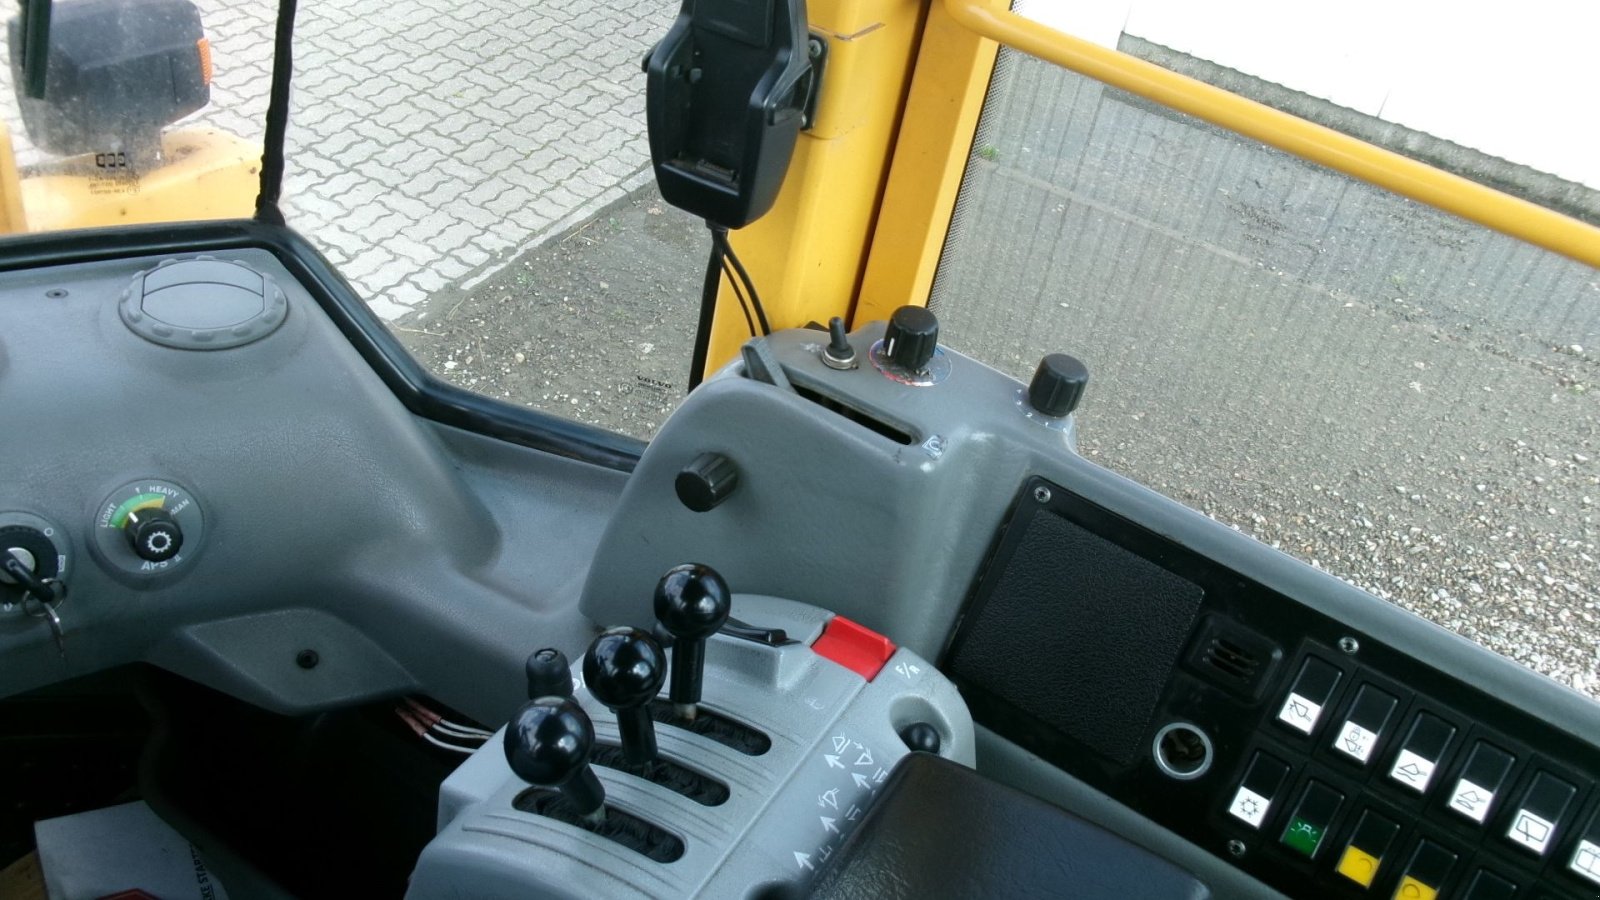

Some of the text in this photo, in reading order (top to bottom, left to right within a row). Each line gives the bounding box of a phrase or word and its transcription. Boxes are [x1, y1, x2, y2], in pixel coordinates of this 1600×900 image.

[149, 485, 179, 498] HEAVY
[100, 502, 117, 528] LIGHT
[170, 498, 190, 515] MAN
